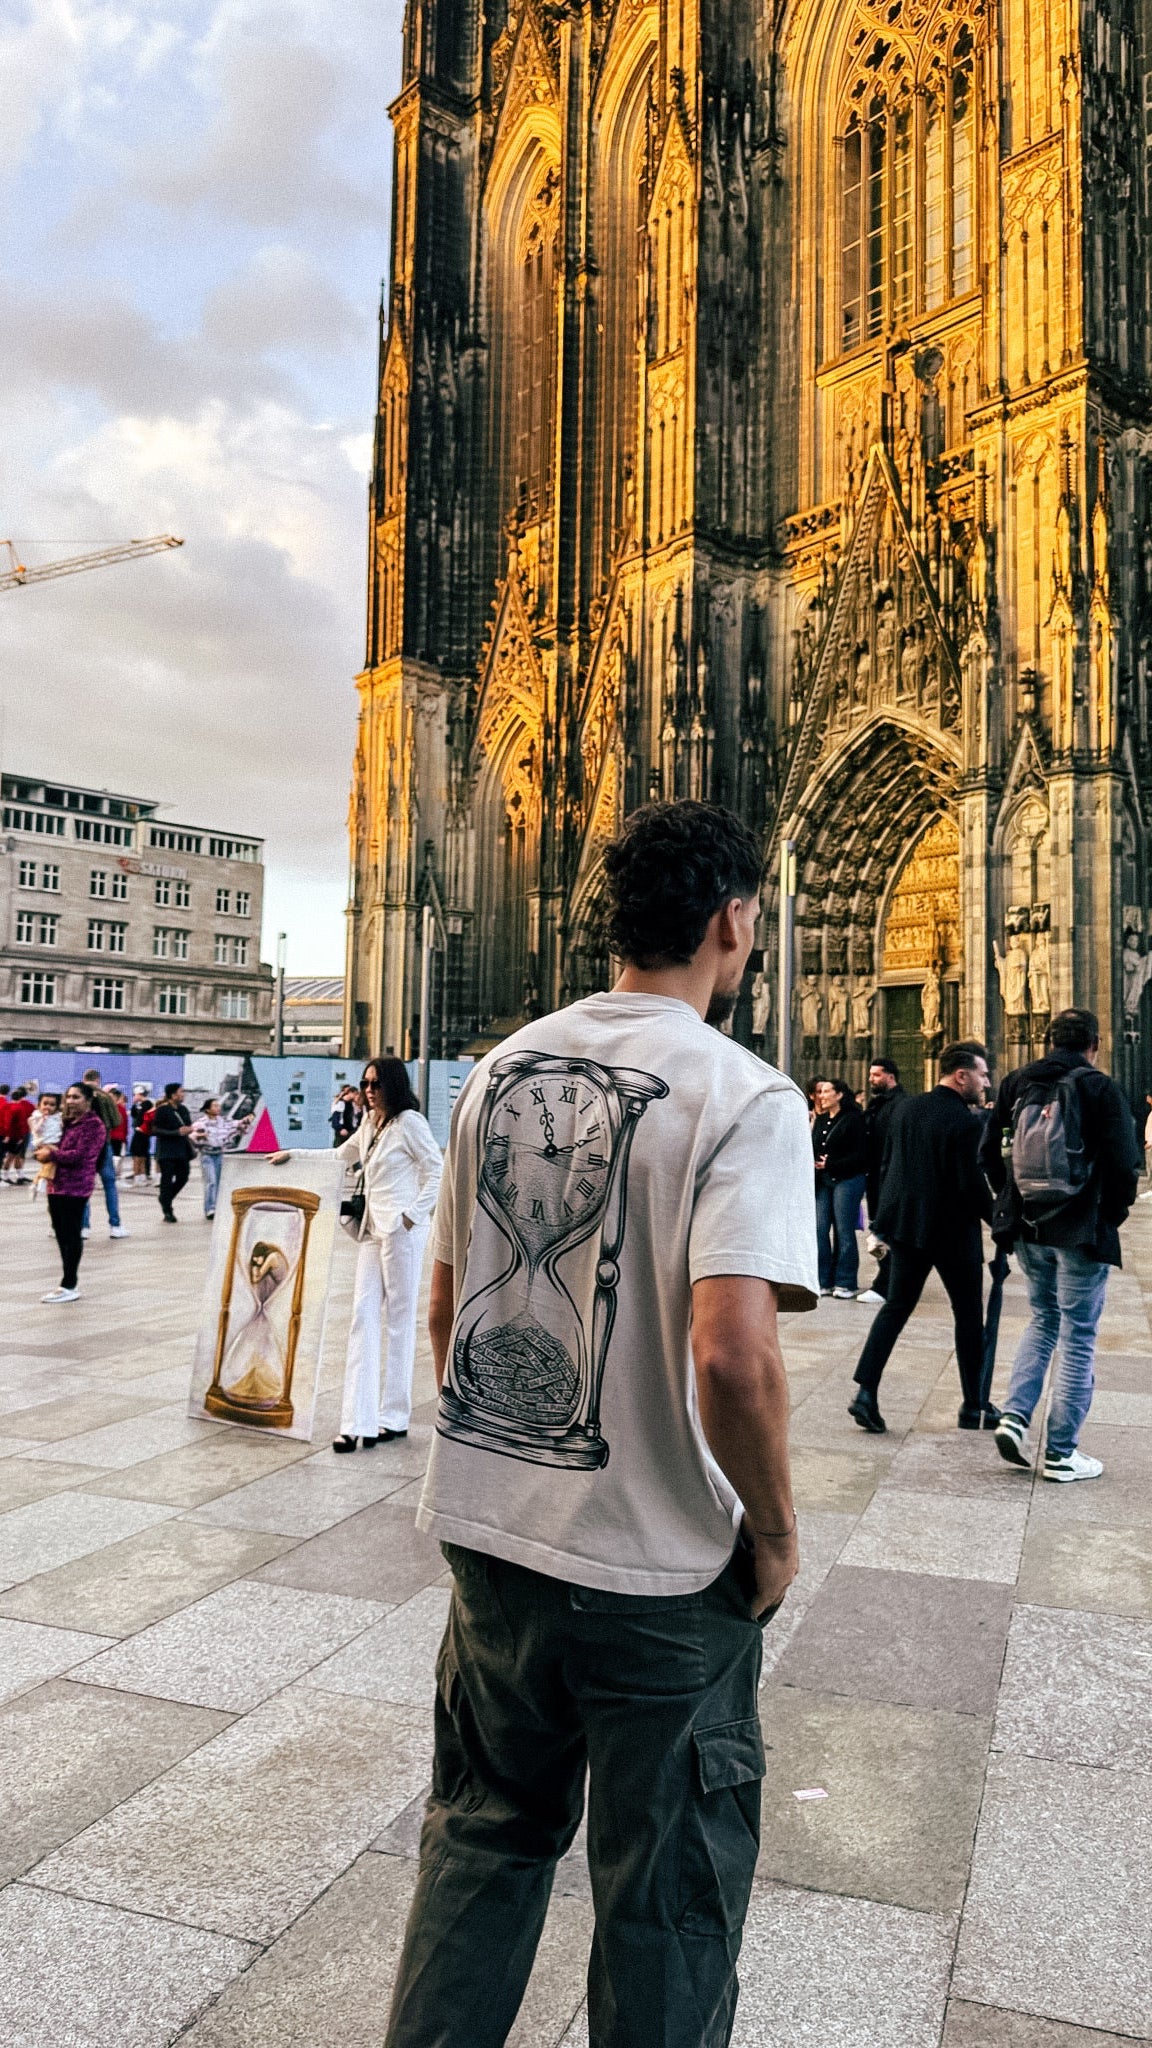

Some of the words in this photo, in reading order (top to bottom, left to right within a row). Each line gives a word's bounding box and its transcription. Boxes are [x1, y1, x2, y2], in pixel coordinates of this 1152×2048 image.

[530, 1087, 546, 1106] XI
[559, 1085, 578, 1105] XII
[506, 1104, 521, 1121] X
[587, 1152, 604, 1167] III
[479, 1366, 491, 1375] VAI
[491, 1367, 514, 1377] PIANO
[540, 1371, 561, 1384] PIANO
